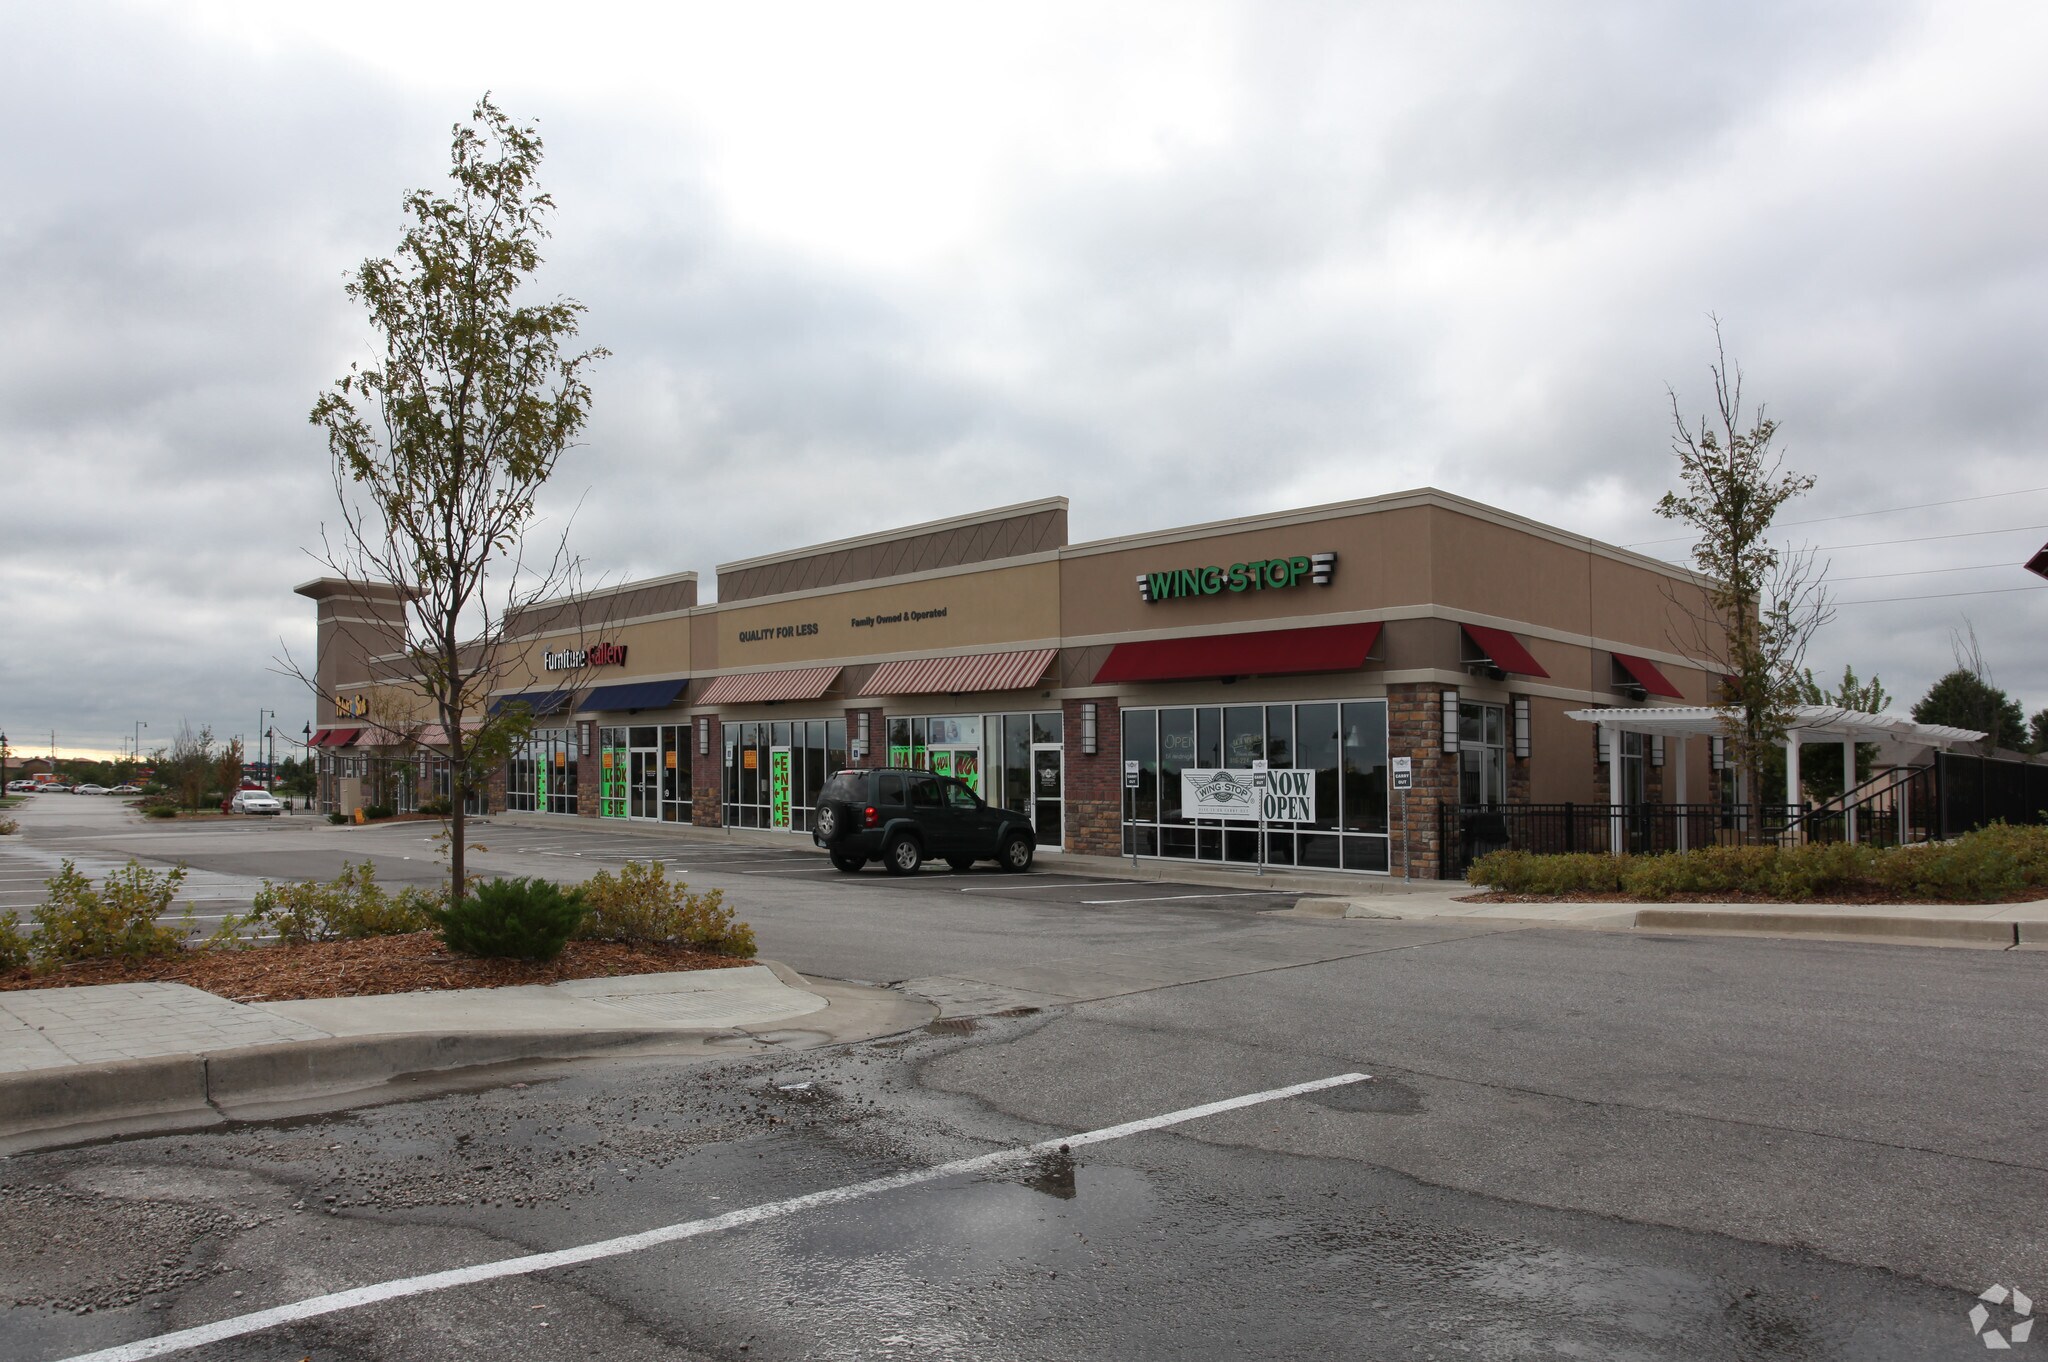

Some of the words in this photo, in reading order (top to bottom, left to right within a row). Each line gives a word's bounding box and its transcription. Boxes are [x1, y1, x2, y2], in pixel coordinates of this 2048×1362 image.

[851, 617, 875, 628] Family
[876, 613, 901, 625] Owned
[903, 612, 909, 621] &
[911, 607, 947, 623] Operated
[739, 628, 775, 643] QUALITY
[776, 626, 794, 638] FOR
[796, 623, 819, 636] LESS
[544, 648, 586, 671] Furniture
[588, 642, 628, 667] Gallery
[1266, 770, 1310, 796] NOW
[1264, 794, 1310, 820] OPEN
